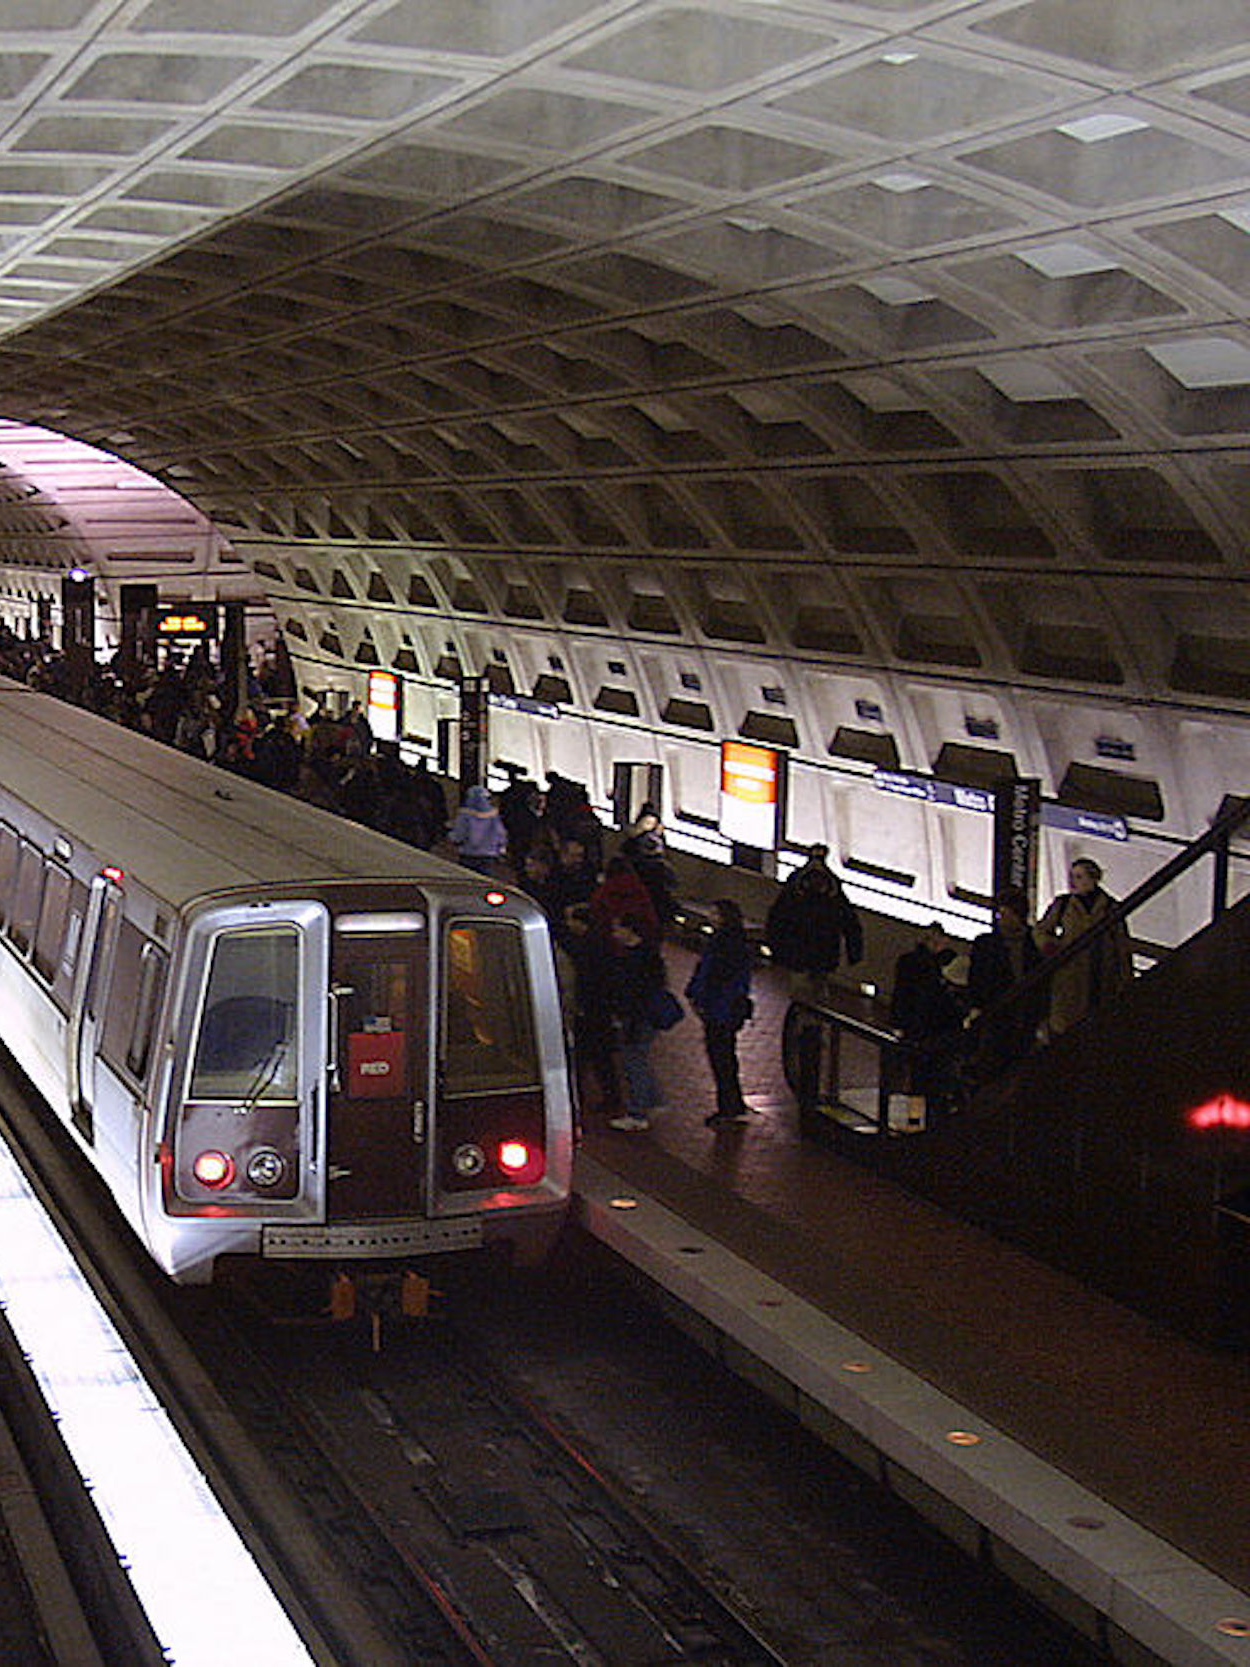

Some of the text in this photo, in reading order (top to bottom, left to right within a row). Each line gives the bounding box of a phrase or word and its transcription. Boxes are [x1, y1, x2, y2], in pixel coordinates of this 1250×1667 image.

[1010, 784, 1029, 888] Metro Center
[360, 1062, 390, 1076] RED
